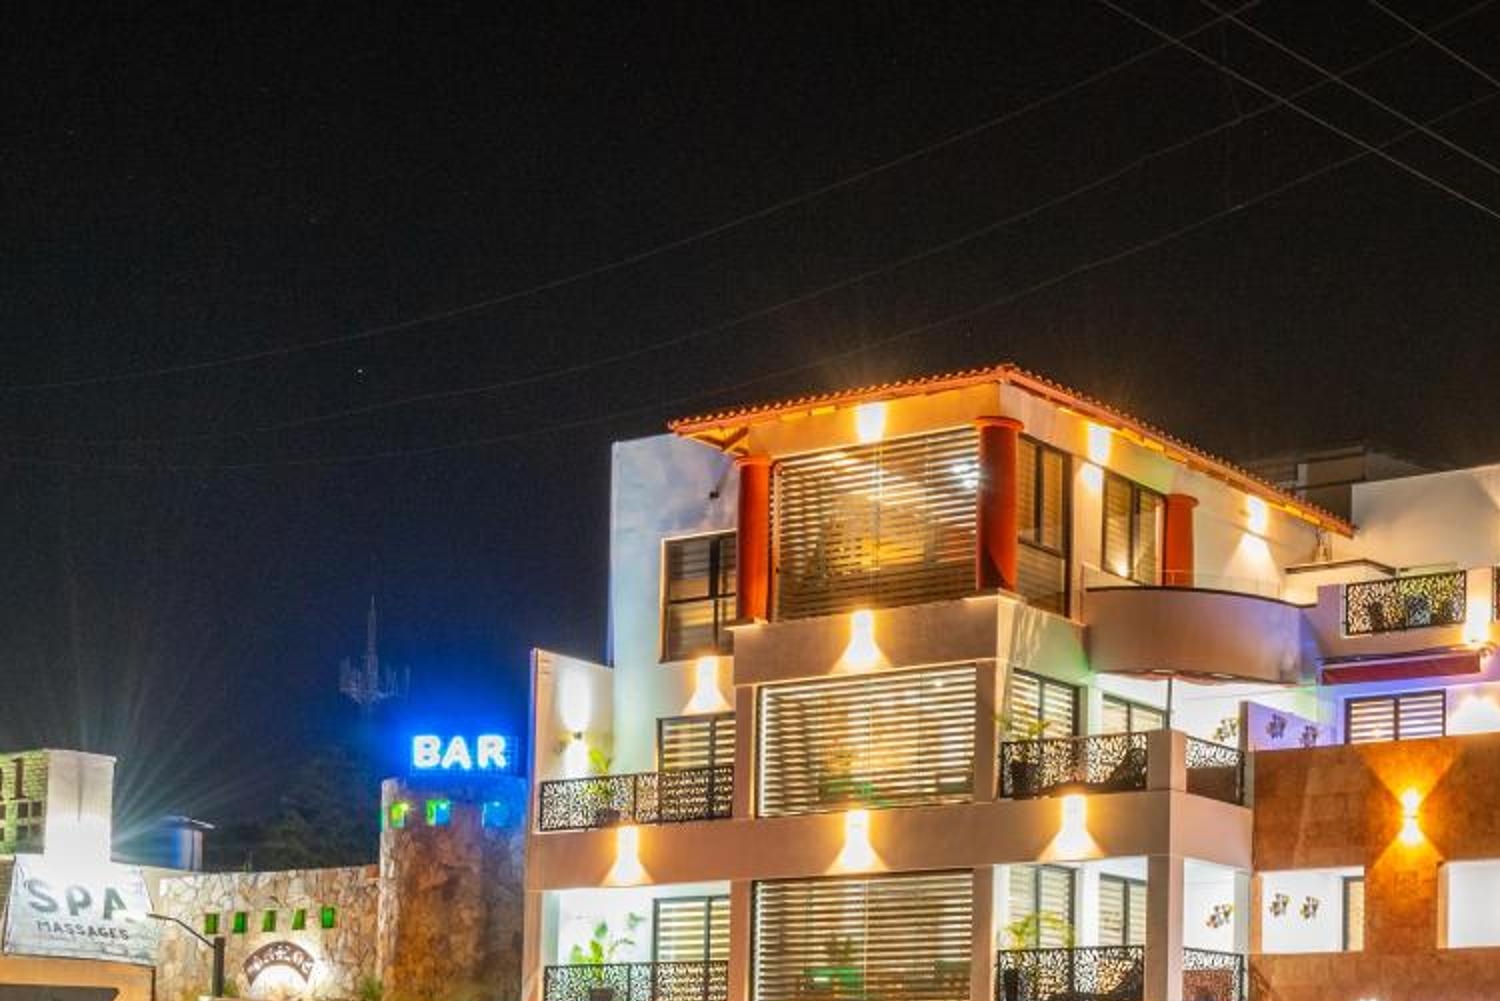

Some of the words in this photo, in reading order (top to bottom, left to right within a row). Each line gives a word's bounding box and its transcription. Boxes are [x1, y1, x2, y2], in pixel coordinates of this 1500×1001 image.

[413, 734, 506, 769] BAR
[24, 877, 128, 922] SPA
[36, 919, 130, 941] MASSAGES
